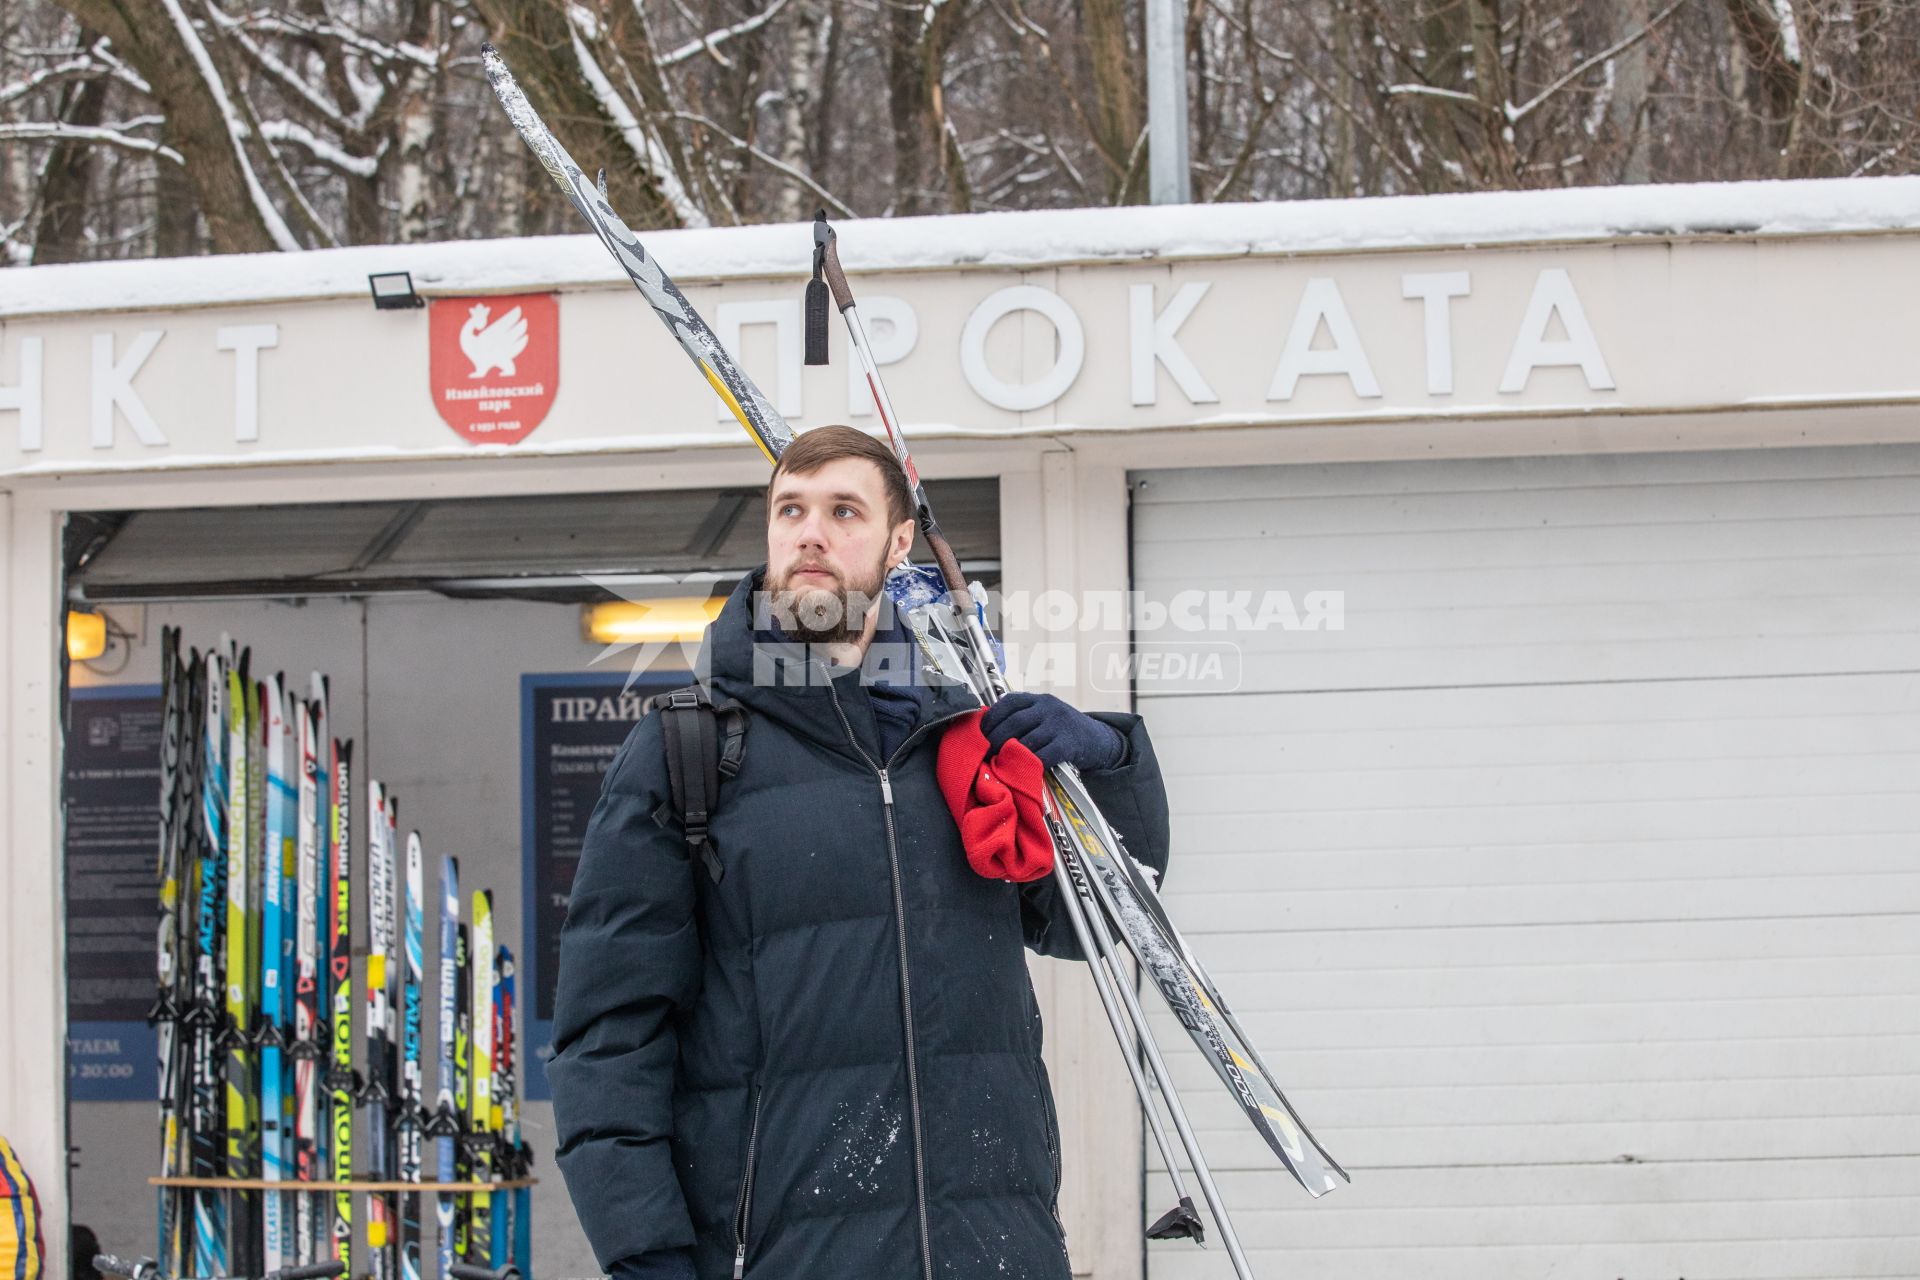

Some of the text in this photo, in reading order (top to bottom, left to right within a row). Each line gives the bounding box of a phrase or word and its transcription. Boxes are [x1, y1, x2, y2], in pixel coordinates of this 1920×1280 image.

[716, 269, 1617, 423] ПРОКАТА
[445, 383, 544, 400] Измайловский
[478, 399, 512, 413] парк
[1053, 820, 1093, 903] SPRINT
[199, 857, 216, 956] ACTIVE
[80, 1063, 134, 1078] 20:00
[1225, 1063, 1258, 1109] 200
